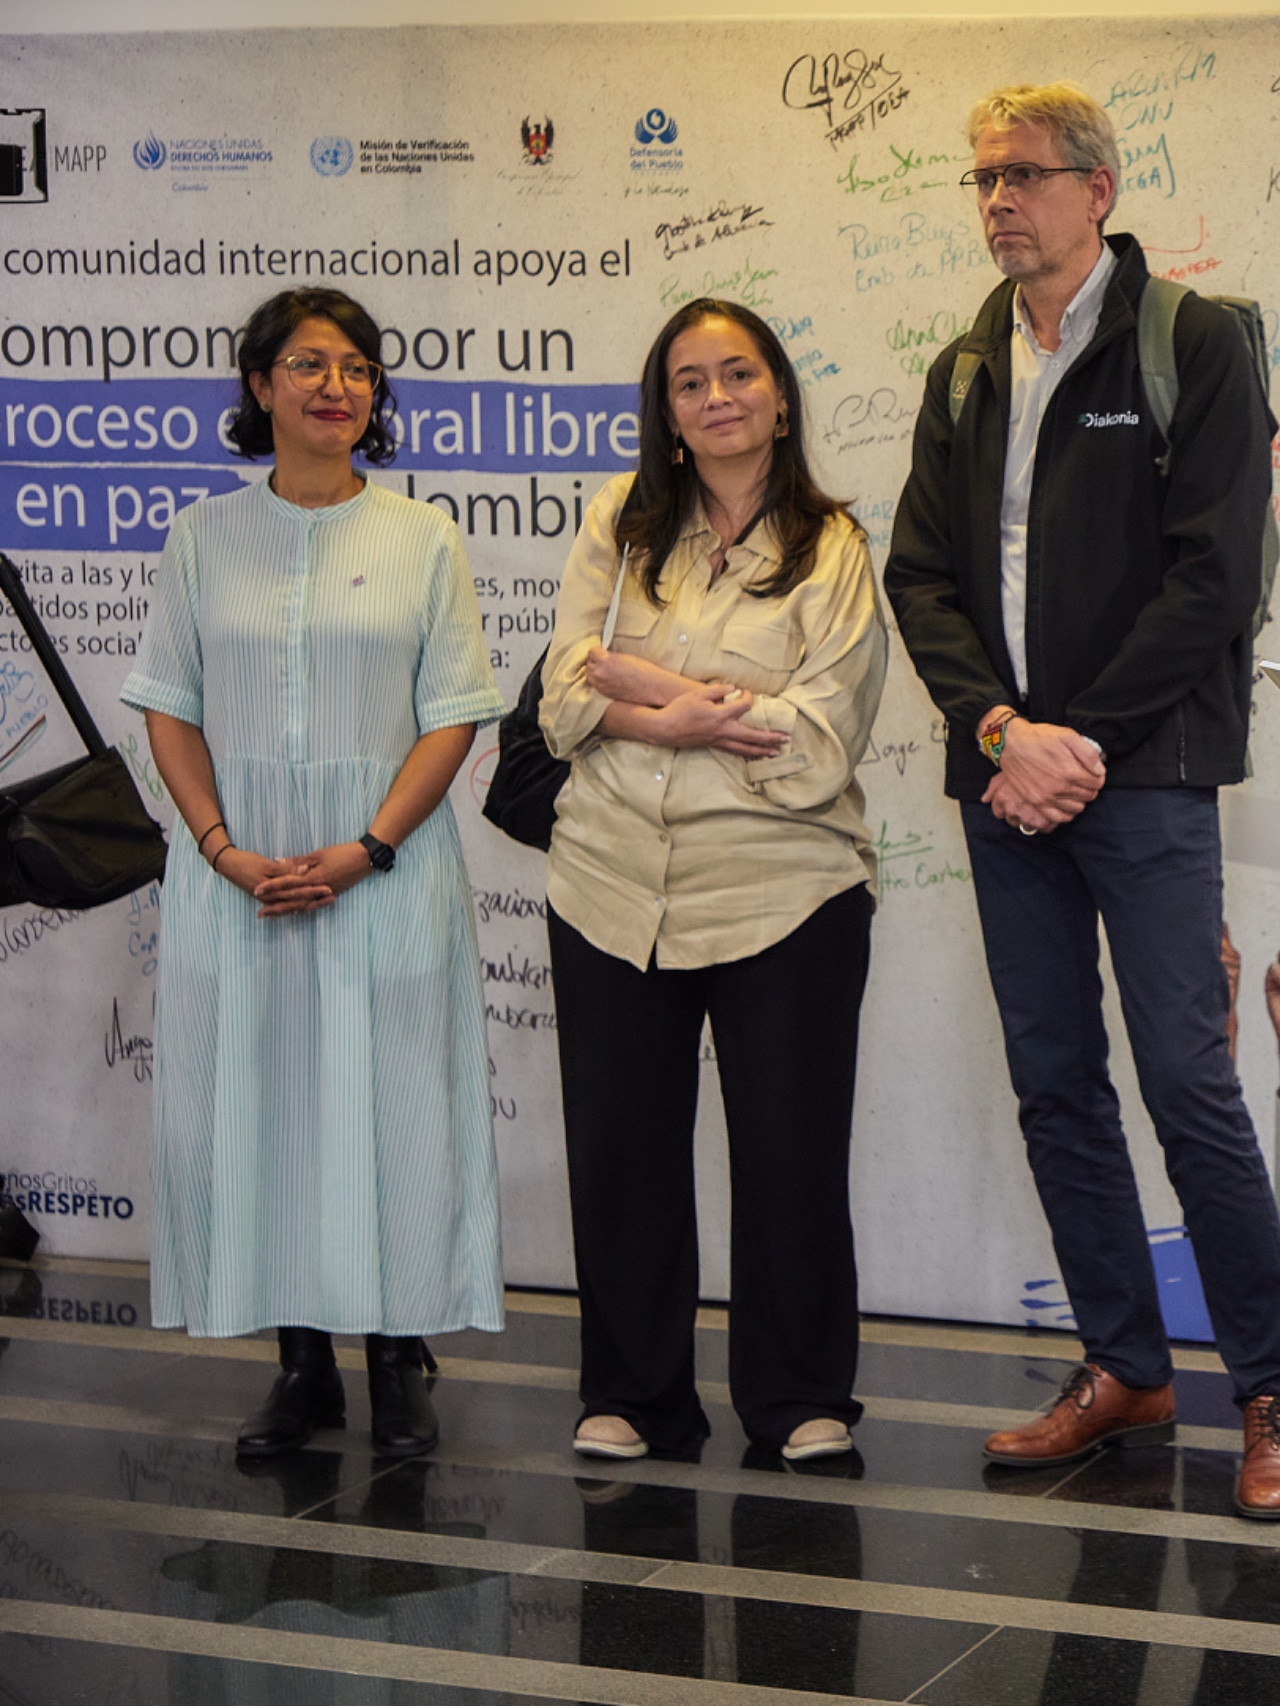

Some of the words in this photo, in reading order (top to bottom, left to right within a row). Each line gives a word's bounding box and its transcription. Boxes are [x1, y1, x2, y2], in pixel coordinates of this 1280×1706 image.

[170, 138, 223, 150] NACIONES
[226, 138, 263, 150] UNIDAS
[360, 139, 393, 150] Misión
[395, 139, 408, 150] de
[411, 139, 469, 150] Verificación
[54, 144, 107, 172] MAPP
[170, 151, 219, 162] DERECHOS
[222, 151, 273, 162] HUMANOS
[360, 152, 373, 162] de
[375, 152, 389, 161] las
[392, 152, 437, 161] Naciones
[440, 152, 475, 161] Unidas
[630, 160, 646, 170] del
[650, 160, 684, 170] Pueblo
[360, 164, 372, 173] en
[375, 163, 422, 174] Colombia
[3, 238, 206, 276] comunidad
[218, 239, 460, 277] internacional
[473, 248, 588, 287] apoya
[600, 238, 631, 277] el
[0, 324, 246, 384] omprom
[497, 328, 574, 372] un
[5, 403, 198, 450] roceso
[505, 391, 641, 458] libre
[1085, 410, 1139, 428] Diakonia
[16, 482, 86, 528] en
[61, 565, 74, 585] a
[81, 559, 113, 586] las
[120, 568, 133, 592] y
[499, 607, 556, 639] públ
